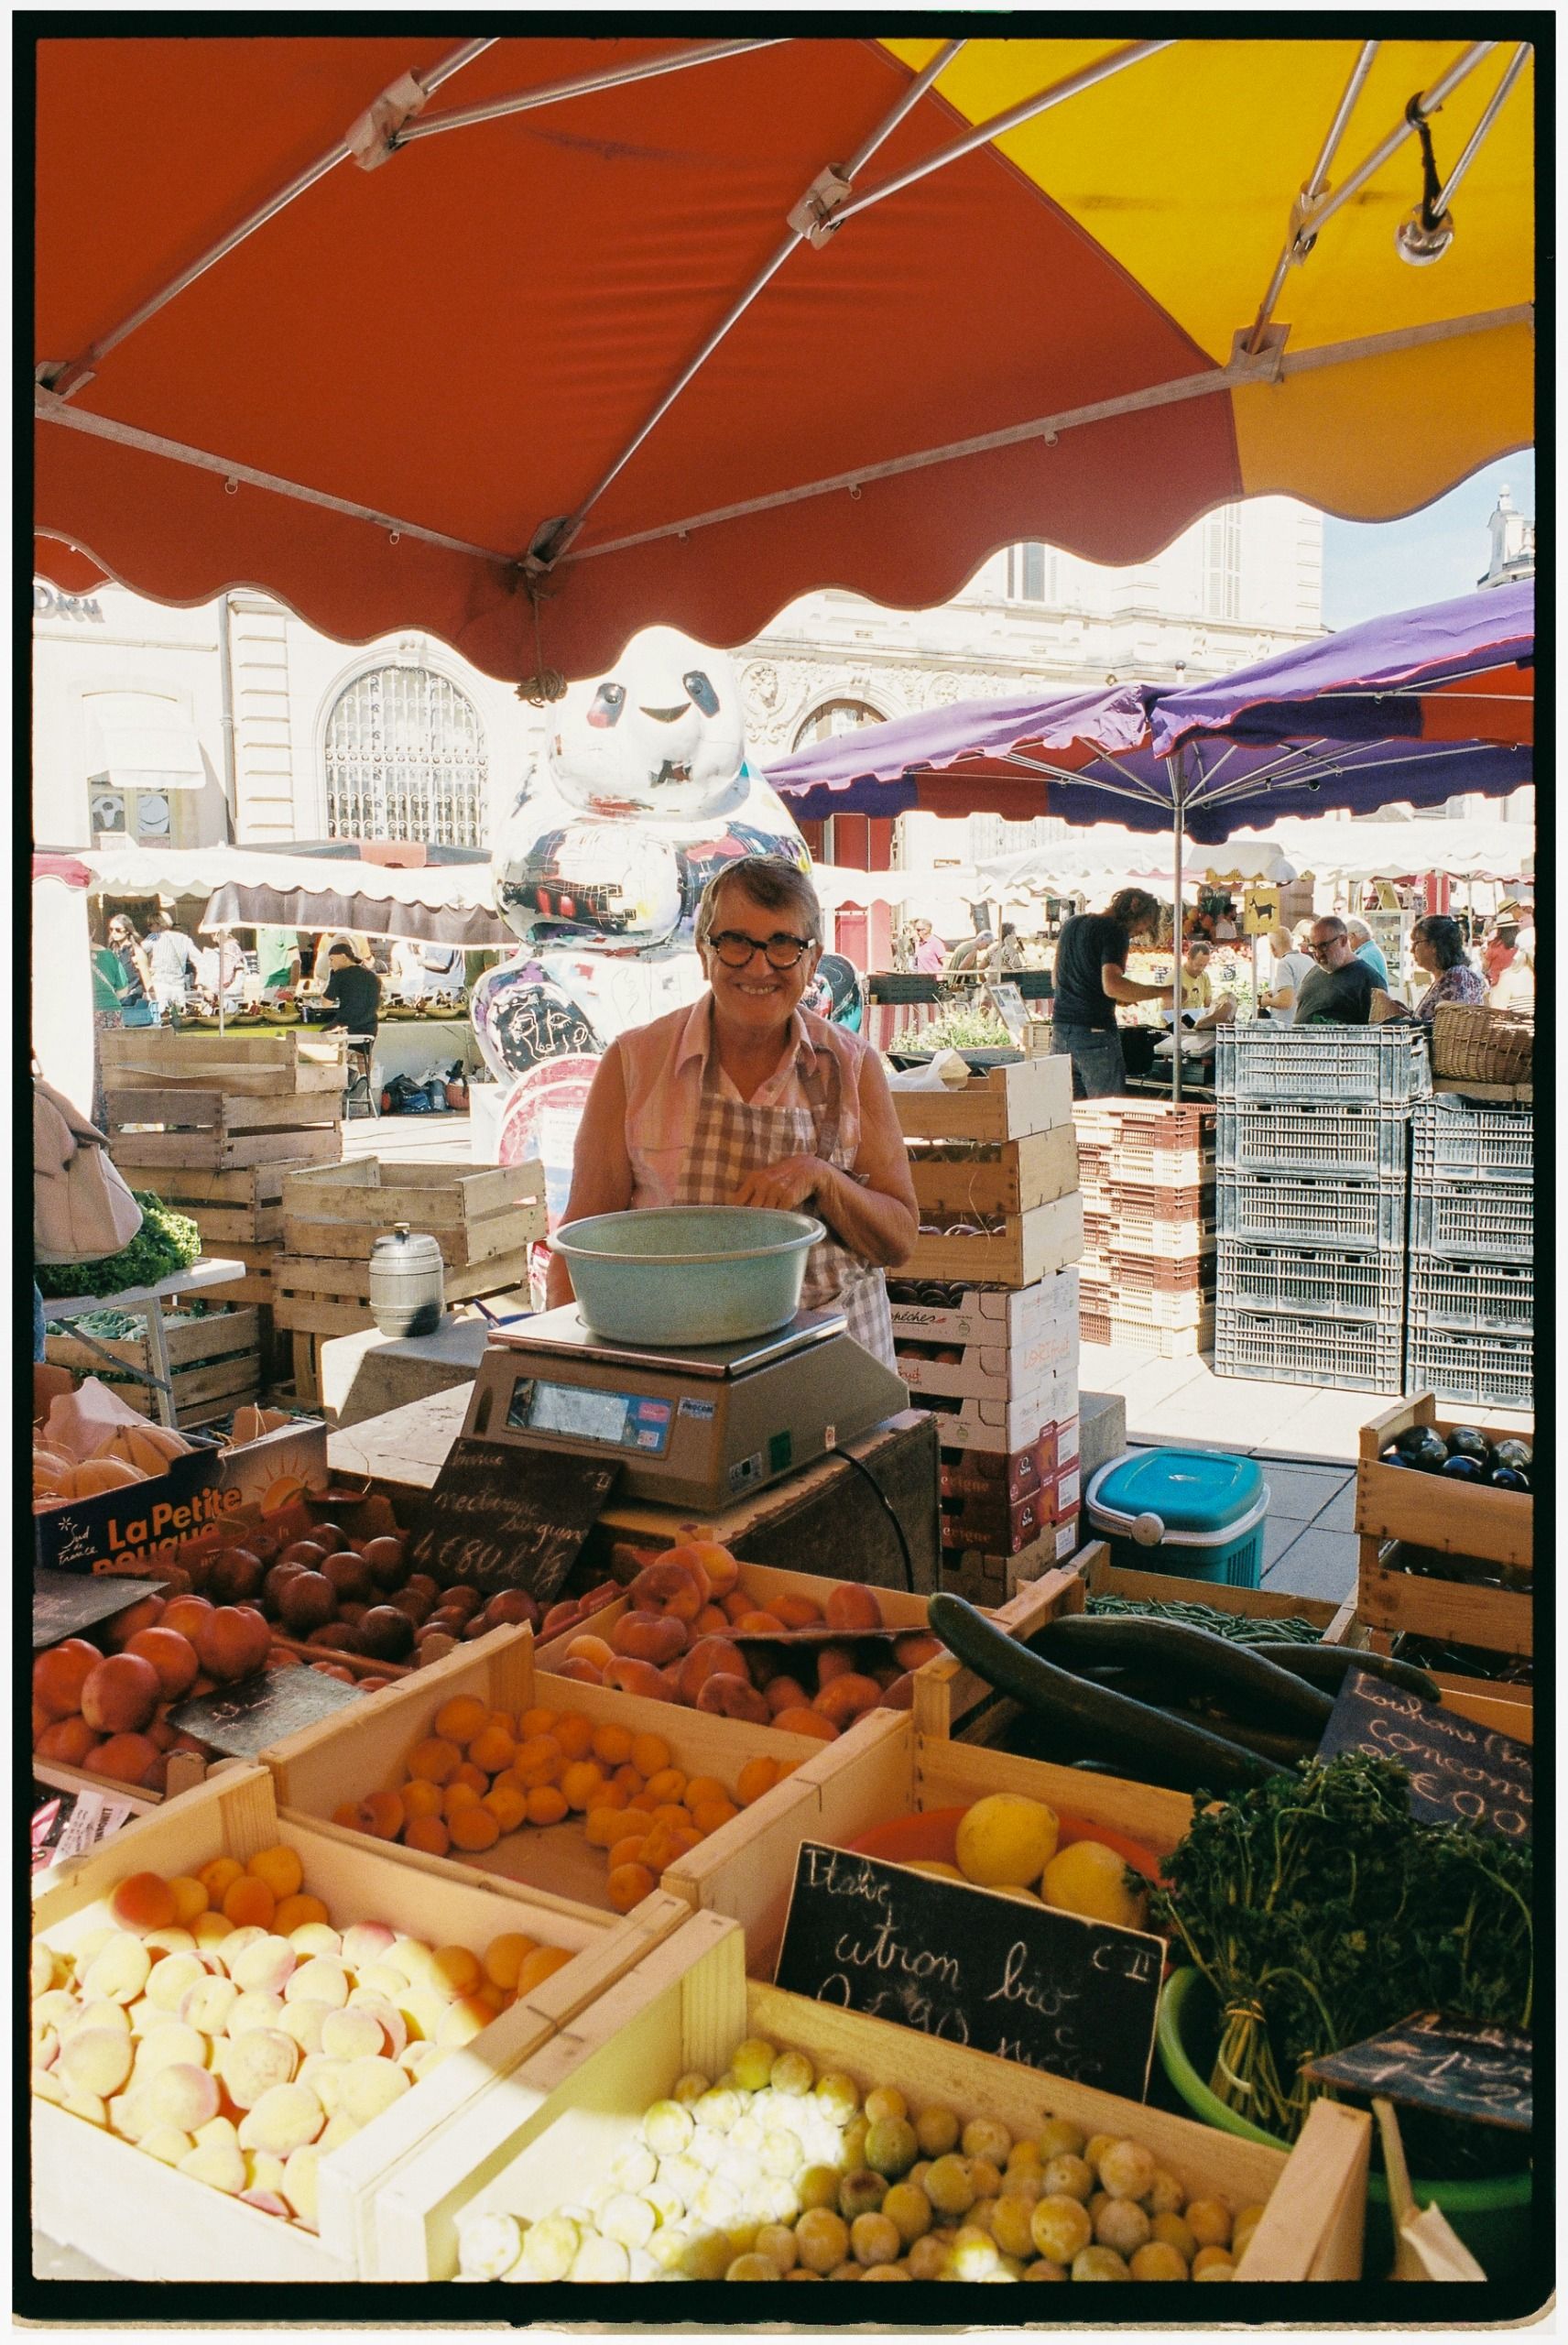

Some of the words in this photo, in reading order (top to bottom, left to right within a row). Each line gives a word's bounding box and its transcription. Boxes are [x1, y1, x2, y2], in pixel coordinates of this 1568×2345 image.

[108, 1518, 147, 1551] La
[151, 1487, 242, 1536] Petite
[68, 1524, 91, 1549] Sud
[58, 1548, 98, 1565] France
